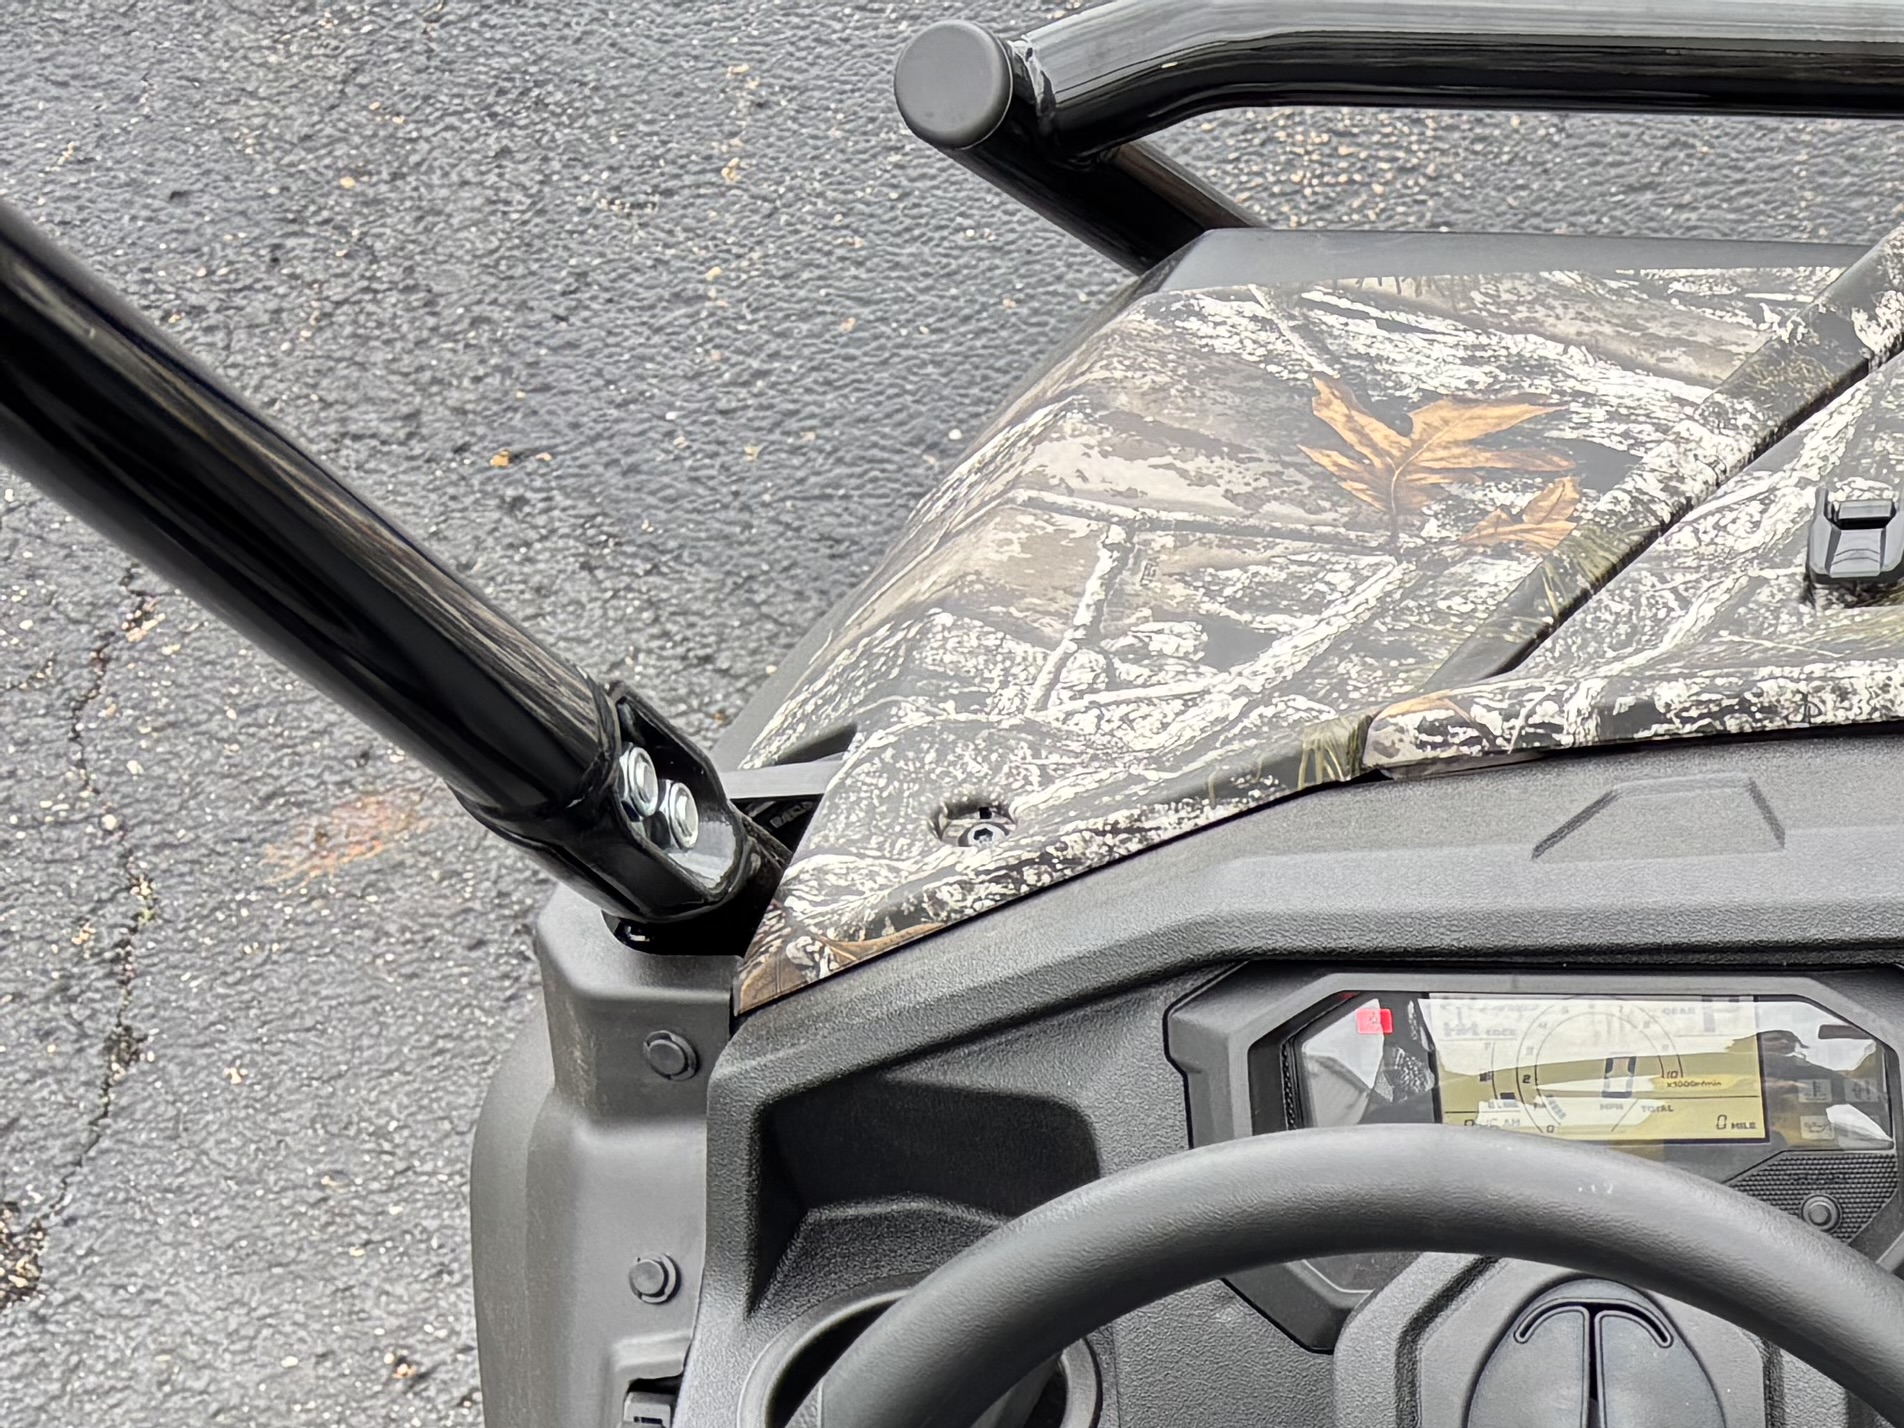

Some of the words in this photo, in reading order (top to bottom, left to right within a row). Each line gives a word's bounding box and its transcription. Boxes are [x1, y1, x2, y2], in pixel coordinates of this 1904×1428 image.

[1522, 1074, 1532, 1084] 2
[1602, 1056, 1636, 1098] 0
[1716, 1114, 1728, 1130] 0
[1731, 1122, 1757, 1130] MILE
